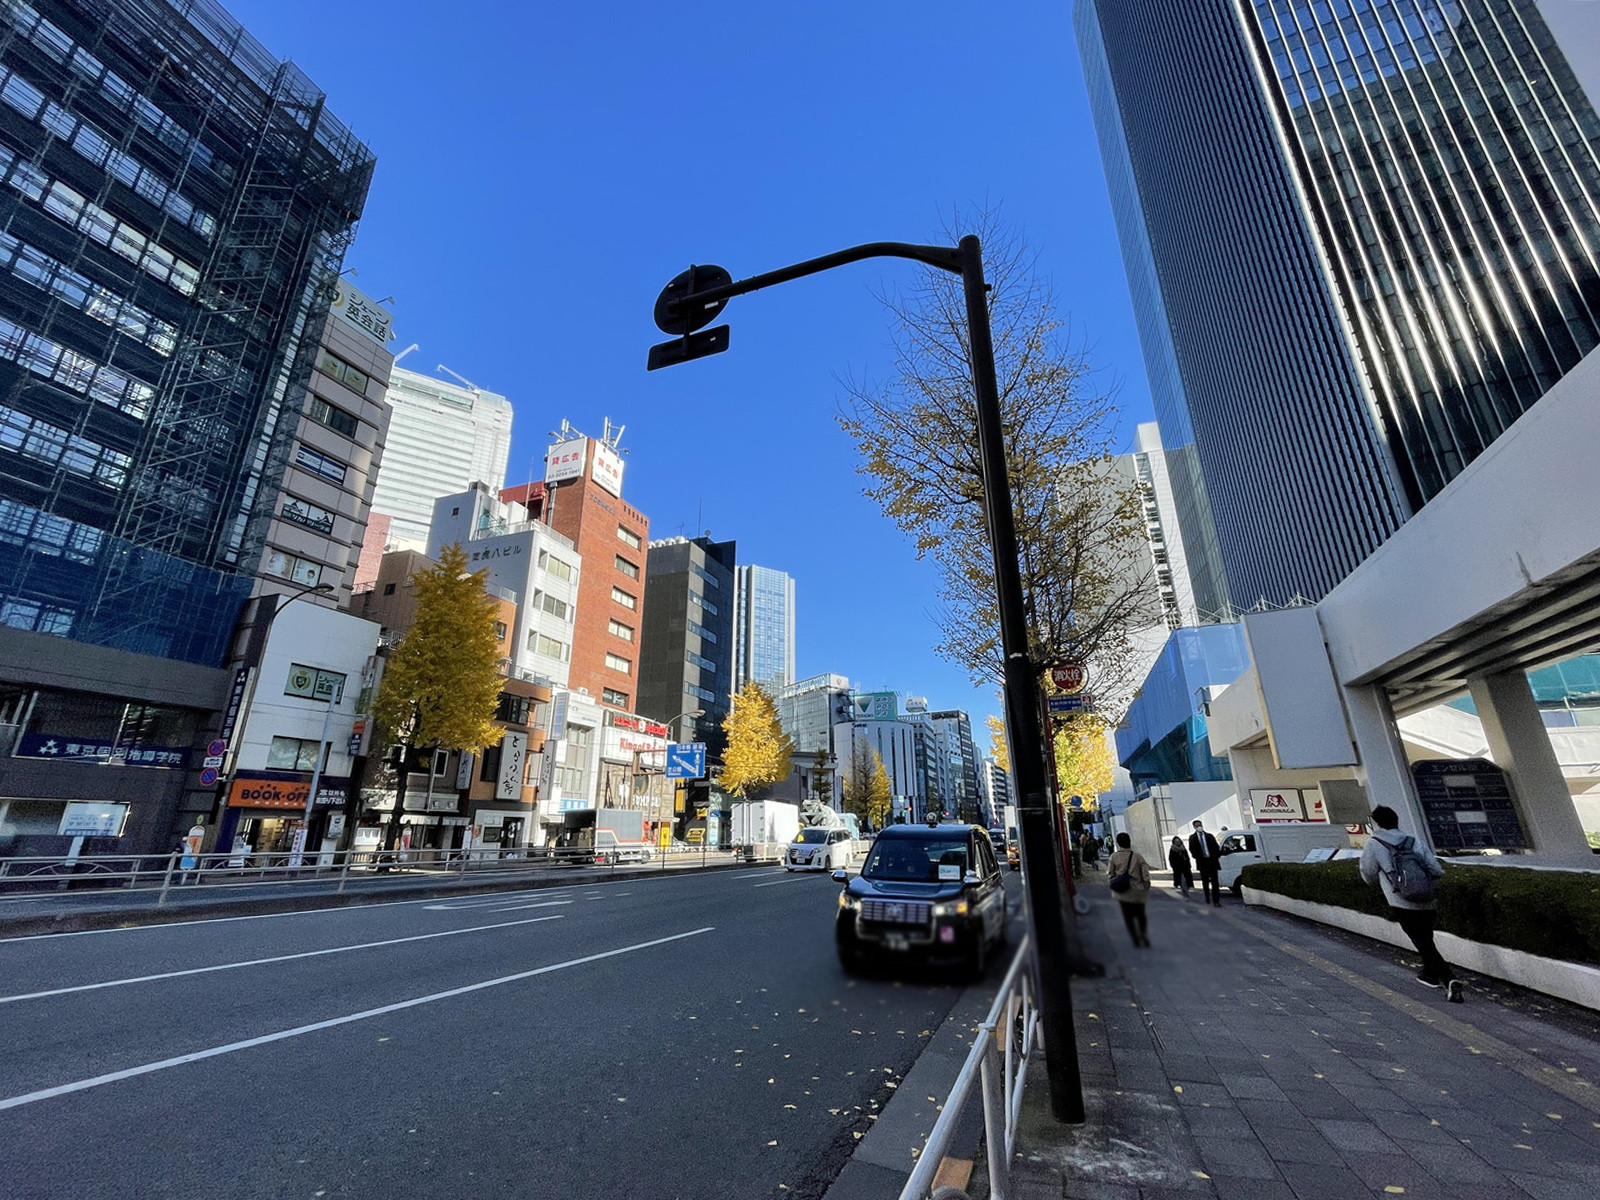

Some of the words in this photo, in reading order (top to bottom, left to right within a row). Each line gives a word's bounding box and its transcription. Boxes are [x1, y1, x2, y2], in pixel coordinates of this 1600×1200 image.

[346, 303, 387, 339] 英会話
[349, 293, 389, 325] シェーン
[1053, 669, 1081, 682] 消火栓
[64, 743, 182, 763] 東京個別指導学院
